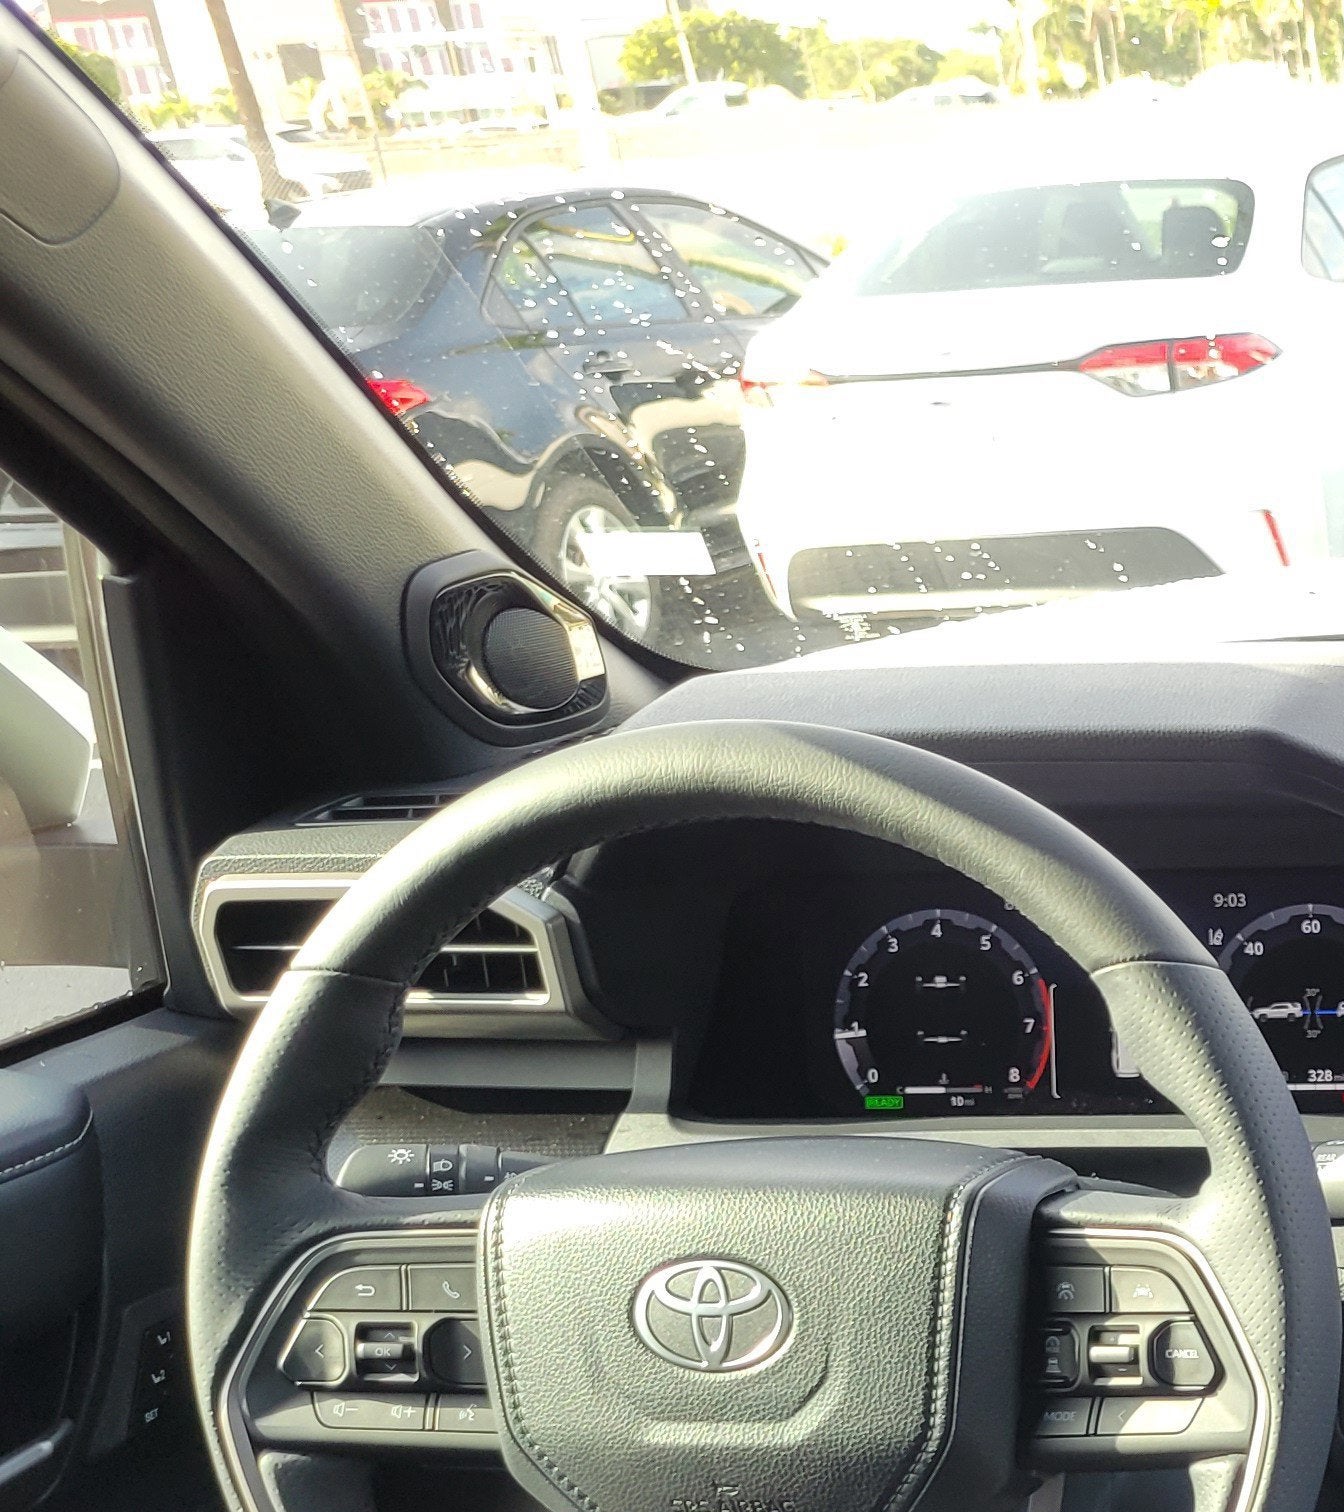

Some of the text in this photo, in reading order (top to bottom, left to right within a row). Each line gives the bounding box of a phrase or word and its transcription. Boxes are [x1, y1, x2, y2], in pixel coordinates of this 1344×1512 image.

[1212, 893, 1247, 908] 9:03
[930, 921, 943, 938] 4
[1300, 919, 1321, 934] 60
[886, 937, 899, 953] 3
[979, 934, 992, 951] 5
[1243, 941, 1264, 956] 40
[857, 972, 870, 988] 2
[1011, 970, 1025, 986] 6
[1023, 1017, 1036, 1034] 7
[867, 1067, 880, 1083] 0
[1008, 1066, 1022, 1083] 8
[1307, 1068, 1333, 1082] 328
[373, 1346, 392, 1358] OK
[1164, 1349, 1200, 1360] CANCEL
[1042, 1410, 1078, 1422] MODE
